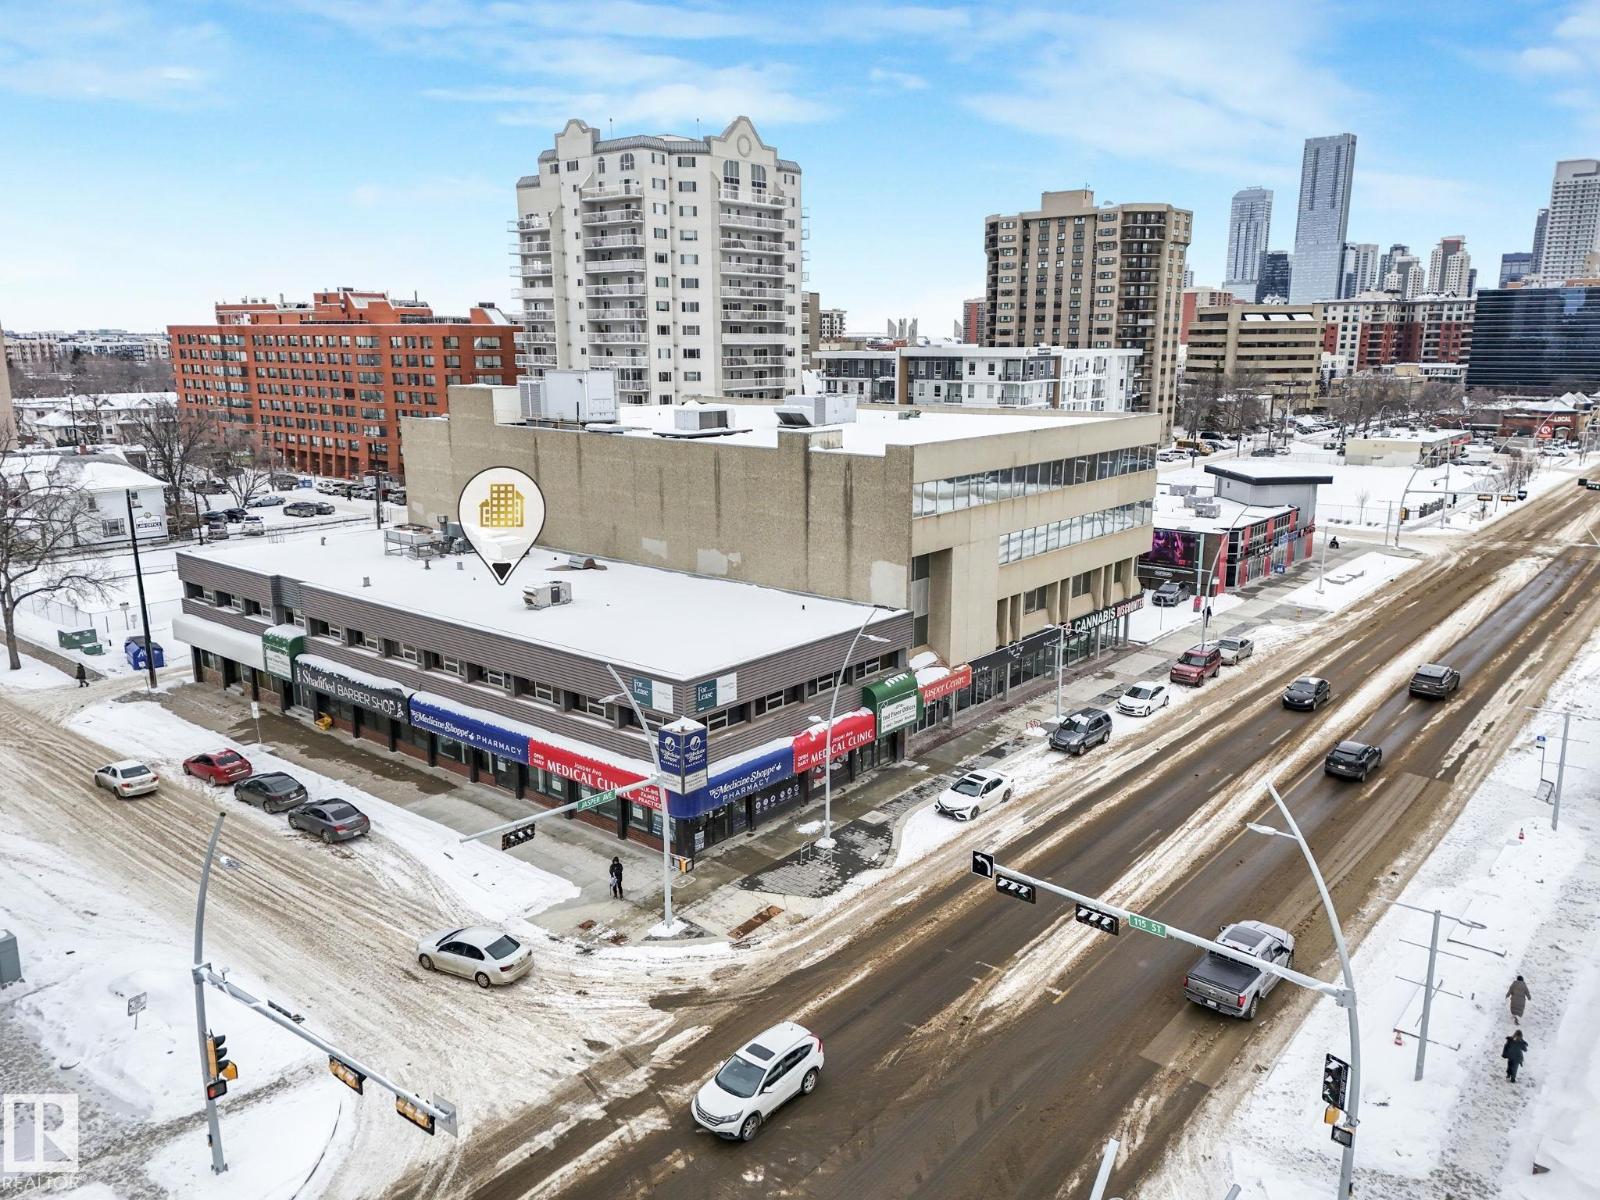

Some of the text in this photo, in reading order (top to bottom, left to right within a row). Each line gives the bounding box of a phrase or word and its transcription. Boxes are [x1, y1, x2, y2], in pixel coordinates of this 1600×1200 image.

[1075, 607, 1116, 633] CANNABIS
[337, 684, 370, 705] BARBER
[371, 696, 395, 714] SHOP
[924, 675, 966, 699] Jasper Centre
[414, 711, 445, 730] Medicine
[476, 735, 522, 755] PHARMACY
[534, 752, 544, 760] OPEN
[811, 729, 873, 763] MEDCAL CLINIC
[547, 760, 594, 786] MEDICAL
[574, 761, 592, 773] Jasper
[581, 791, 613, 808] JASPER AVE
[640, 792, 659, 802] FAMILY
[713, 776, 750, 799] Medicine
[722, 777, 769, 802] PHARMACY
[1134, 917, 1162, 933] 115 ST
